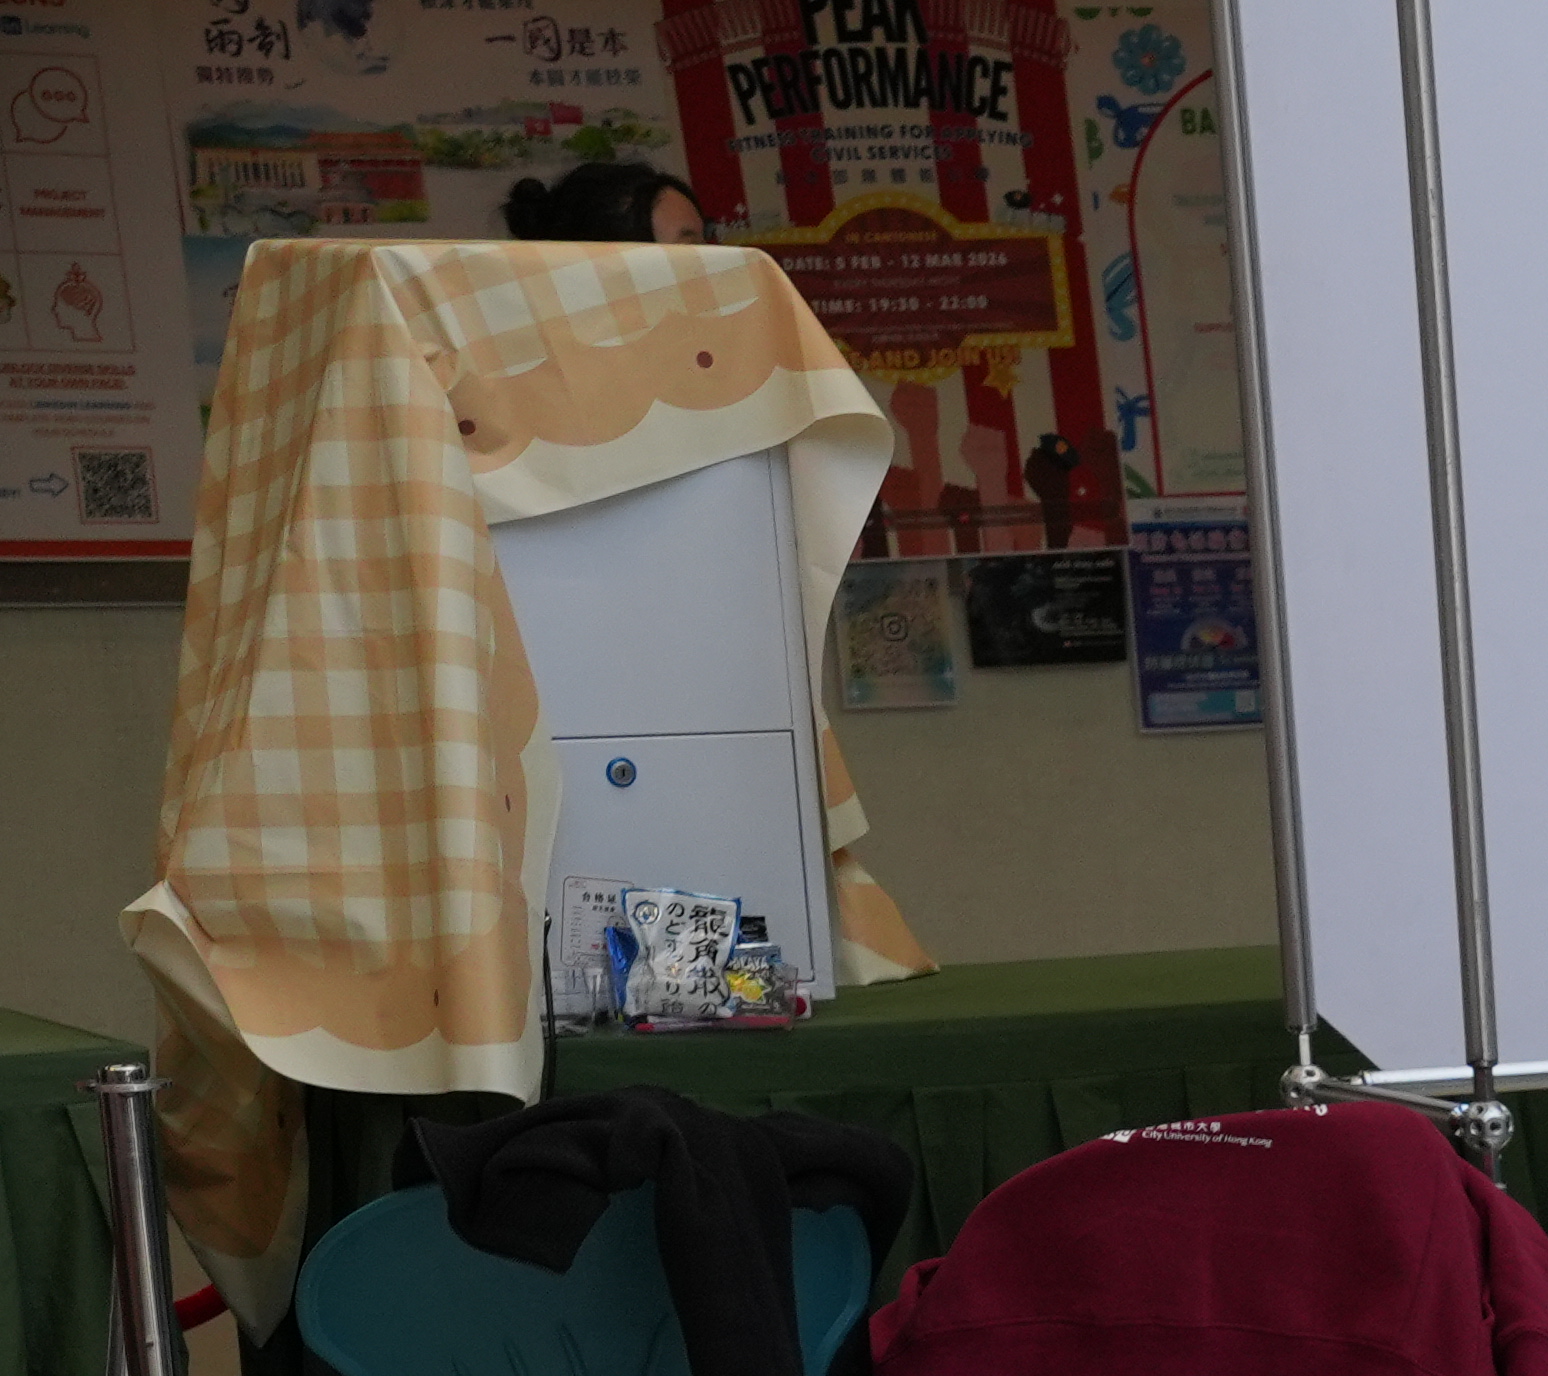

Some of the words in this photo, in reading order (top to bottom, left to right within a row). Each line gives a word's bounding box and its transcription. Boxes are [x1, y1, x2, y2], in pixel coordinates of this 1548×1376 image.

[727, 46, 1014, 125] PERFORMANCE
[728, 130, 796, 152] FITNESS
[797, 126, 892, 146] TRAINING
[899, 125, 934, 140] FOR
[811, 145, 862, 163] CIVIL
[867, 145, 952, 161] SERVICES
[1142, 1130, 1162, 1141] City
[1163, 1131, 1210, 1144] University
[1211, 1133, 1223, 1143] of
[1224, 1134, 1249, 1147] Hong
[1249, 1137, 1273, 1148] Kong
